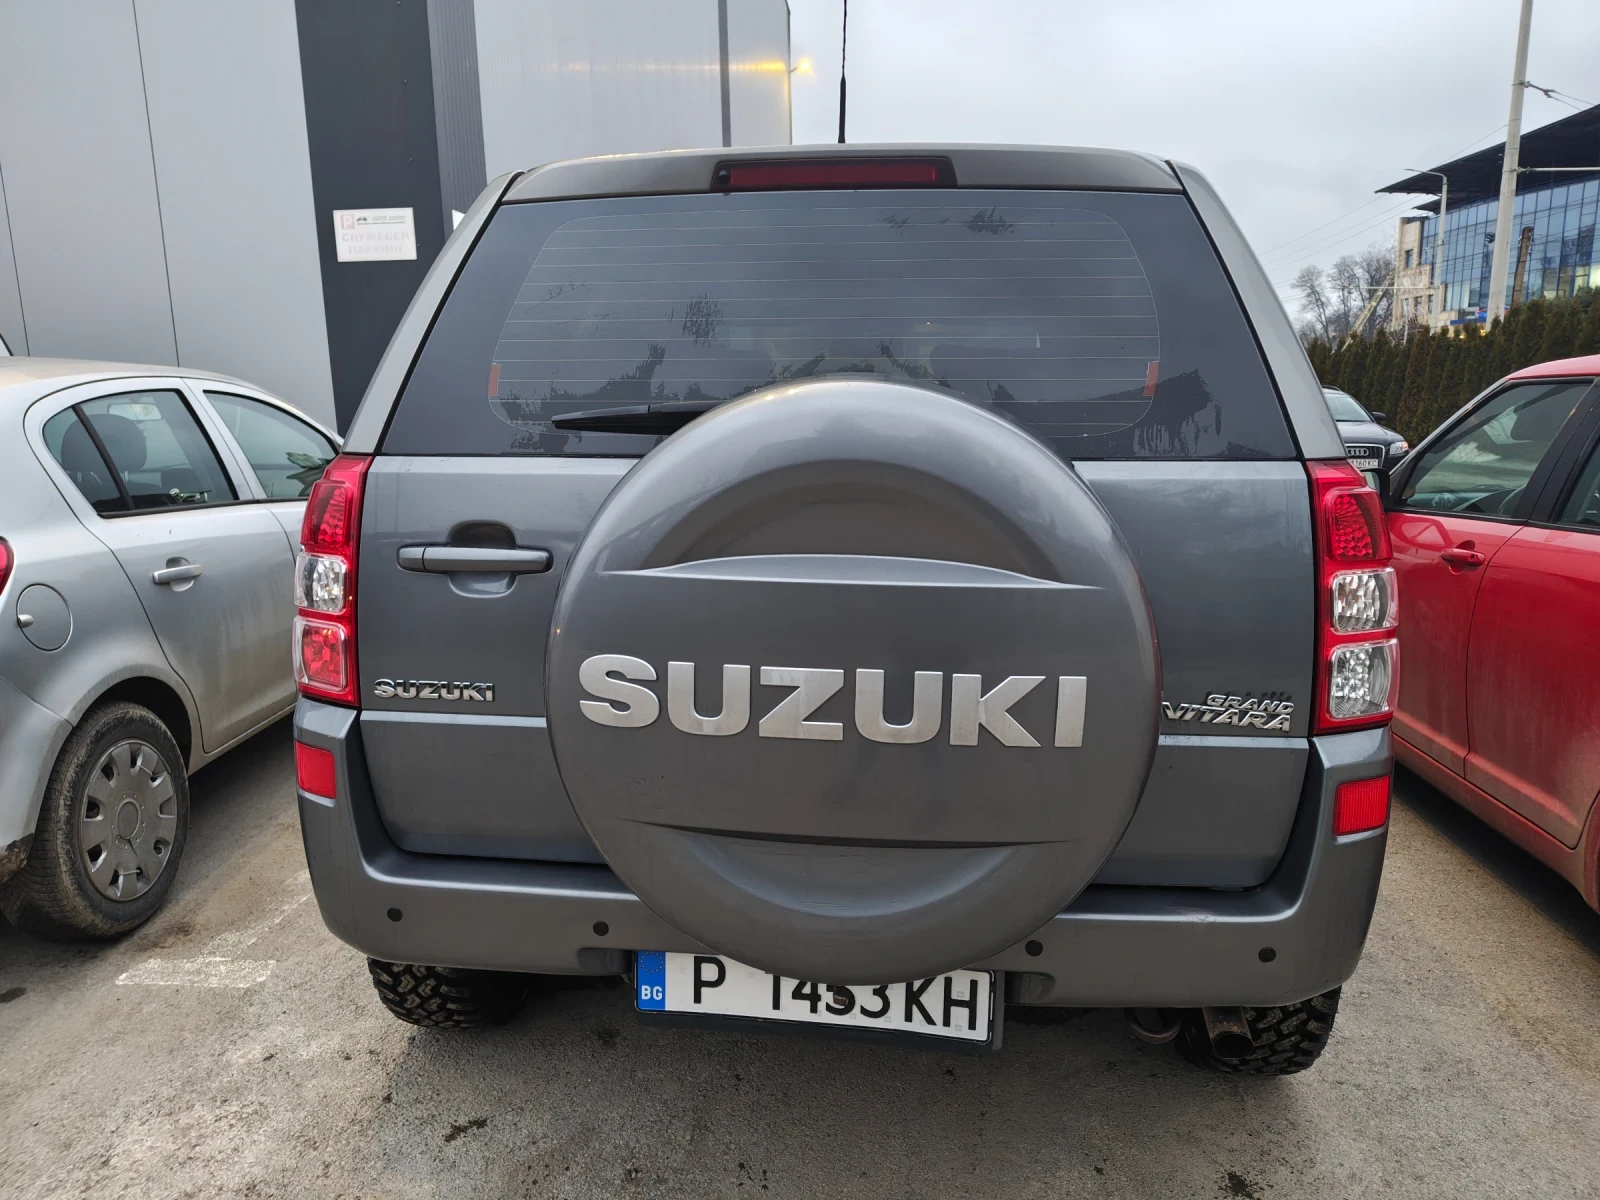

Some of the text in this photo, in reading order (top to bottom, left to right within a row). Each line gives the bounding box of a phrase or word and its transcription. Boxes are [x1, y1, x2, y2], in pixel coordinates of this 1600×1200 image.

[348, 243, 404, 255] ПАРКИНГ
[373, 678, 495, 702] SUZUKI
[579, 653, 1088, 748] SUZUKI
[1206, 694, 1295, 714] GRAND
[1161, 701, 1291, 732] VITARA
[693, 955, 727, 1004] P
[640, 985, 663, 1001] BG
